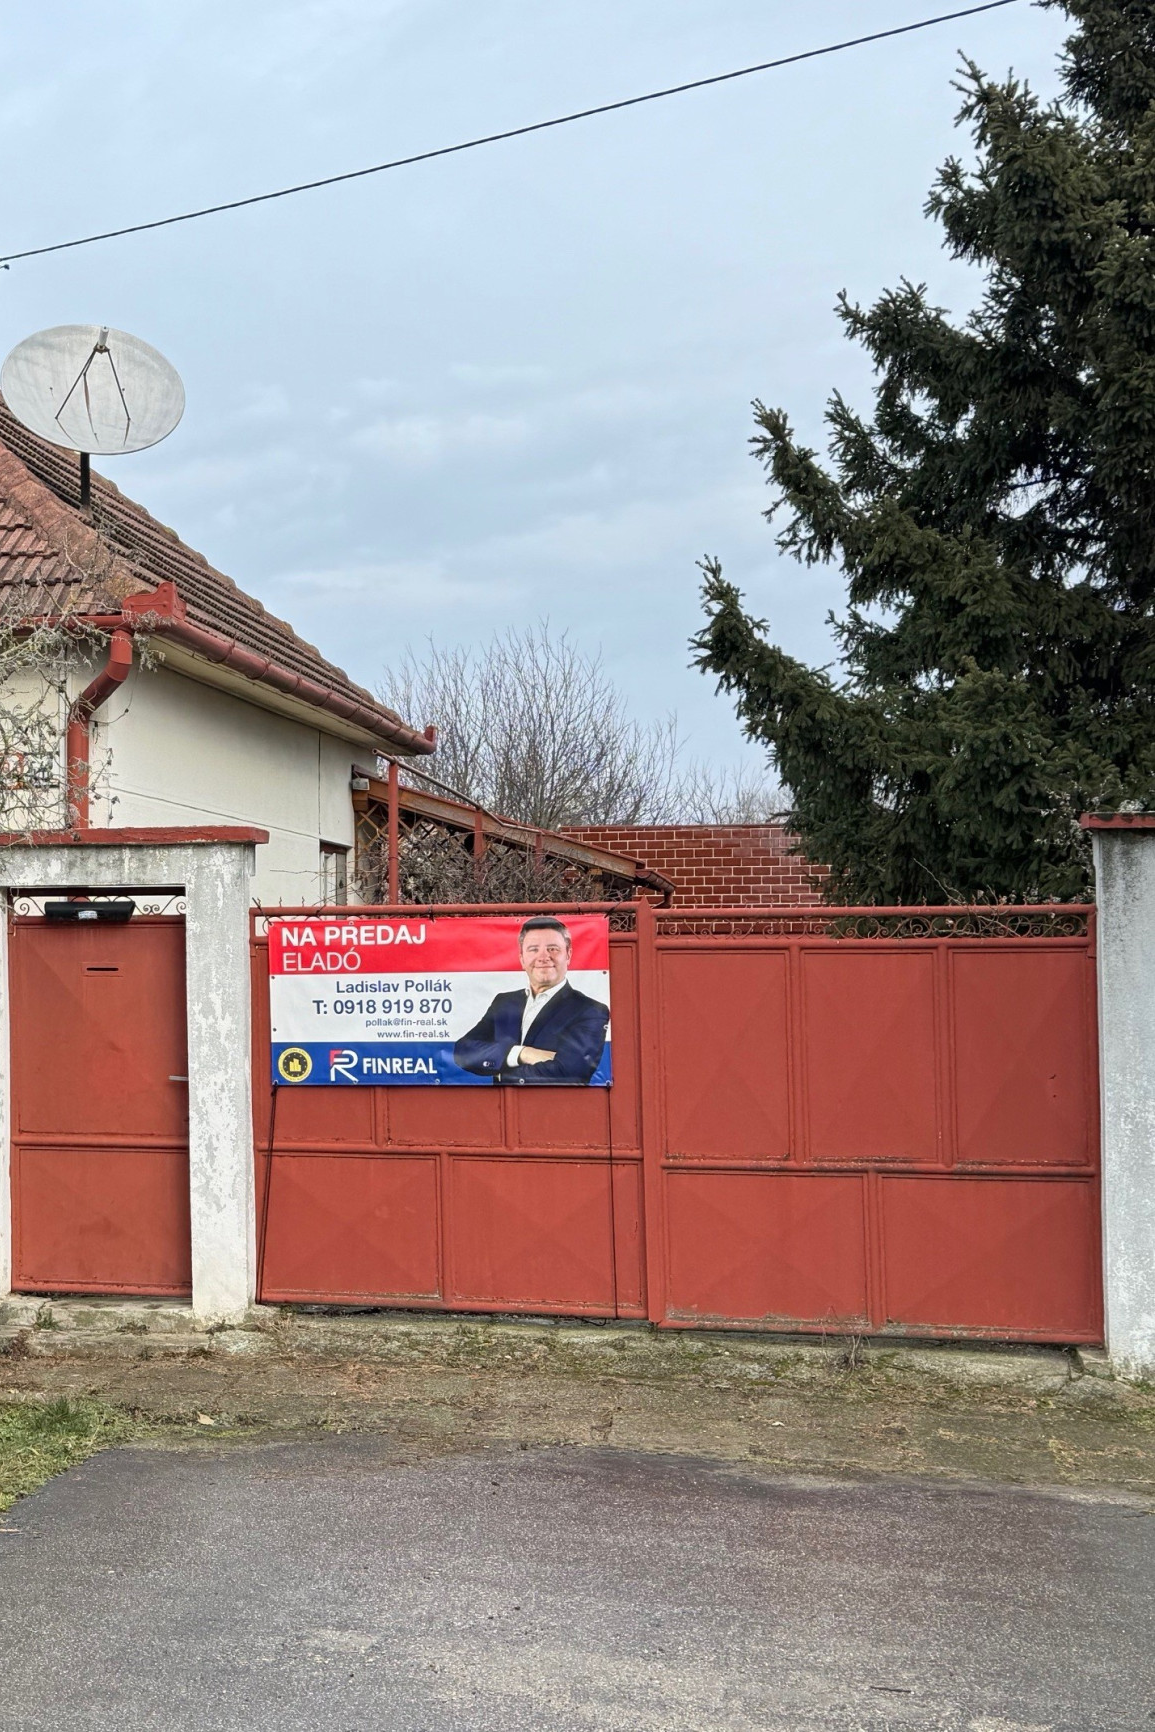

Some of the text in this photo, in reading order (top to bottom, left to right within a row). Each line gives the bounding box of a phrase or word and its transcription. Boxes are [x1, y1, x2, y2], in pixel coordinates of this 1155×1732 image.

[281, 924, 426, 947] NA PREDAJ
[282, 947, 361, 971] ELADÓ
[336, 979, 452, 993] Ladislav Pollák
[312, 998, 452, 1014] T: 0918 919 870
[365, 1017, 448, 1028] pollak@fin-real.sk
[377, 1029, 450, 1038] www.fin-real.sk
[362, 1057, 438, 1074] FINREAL
